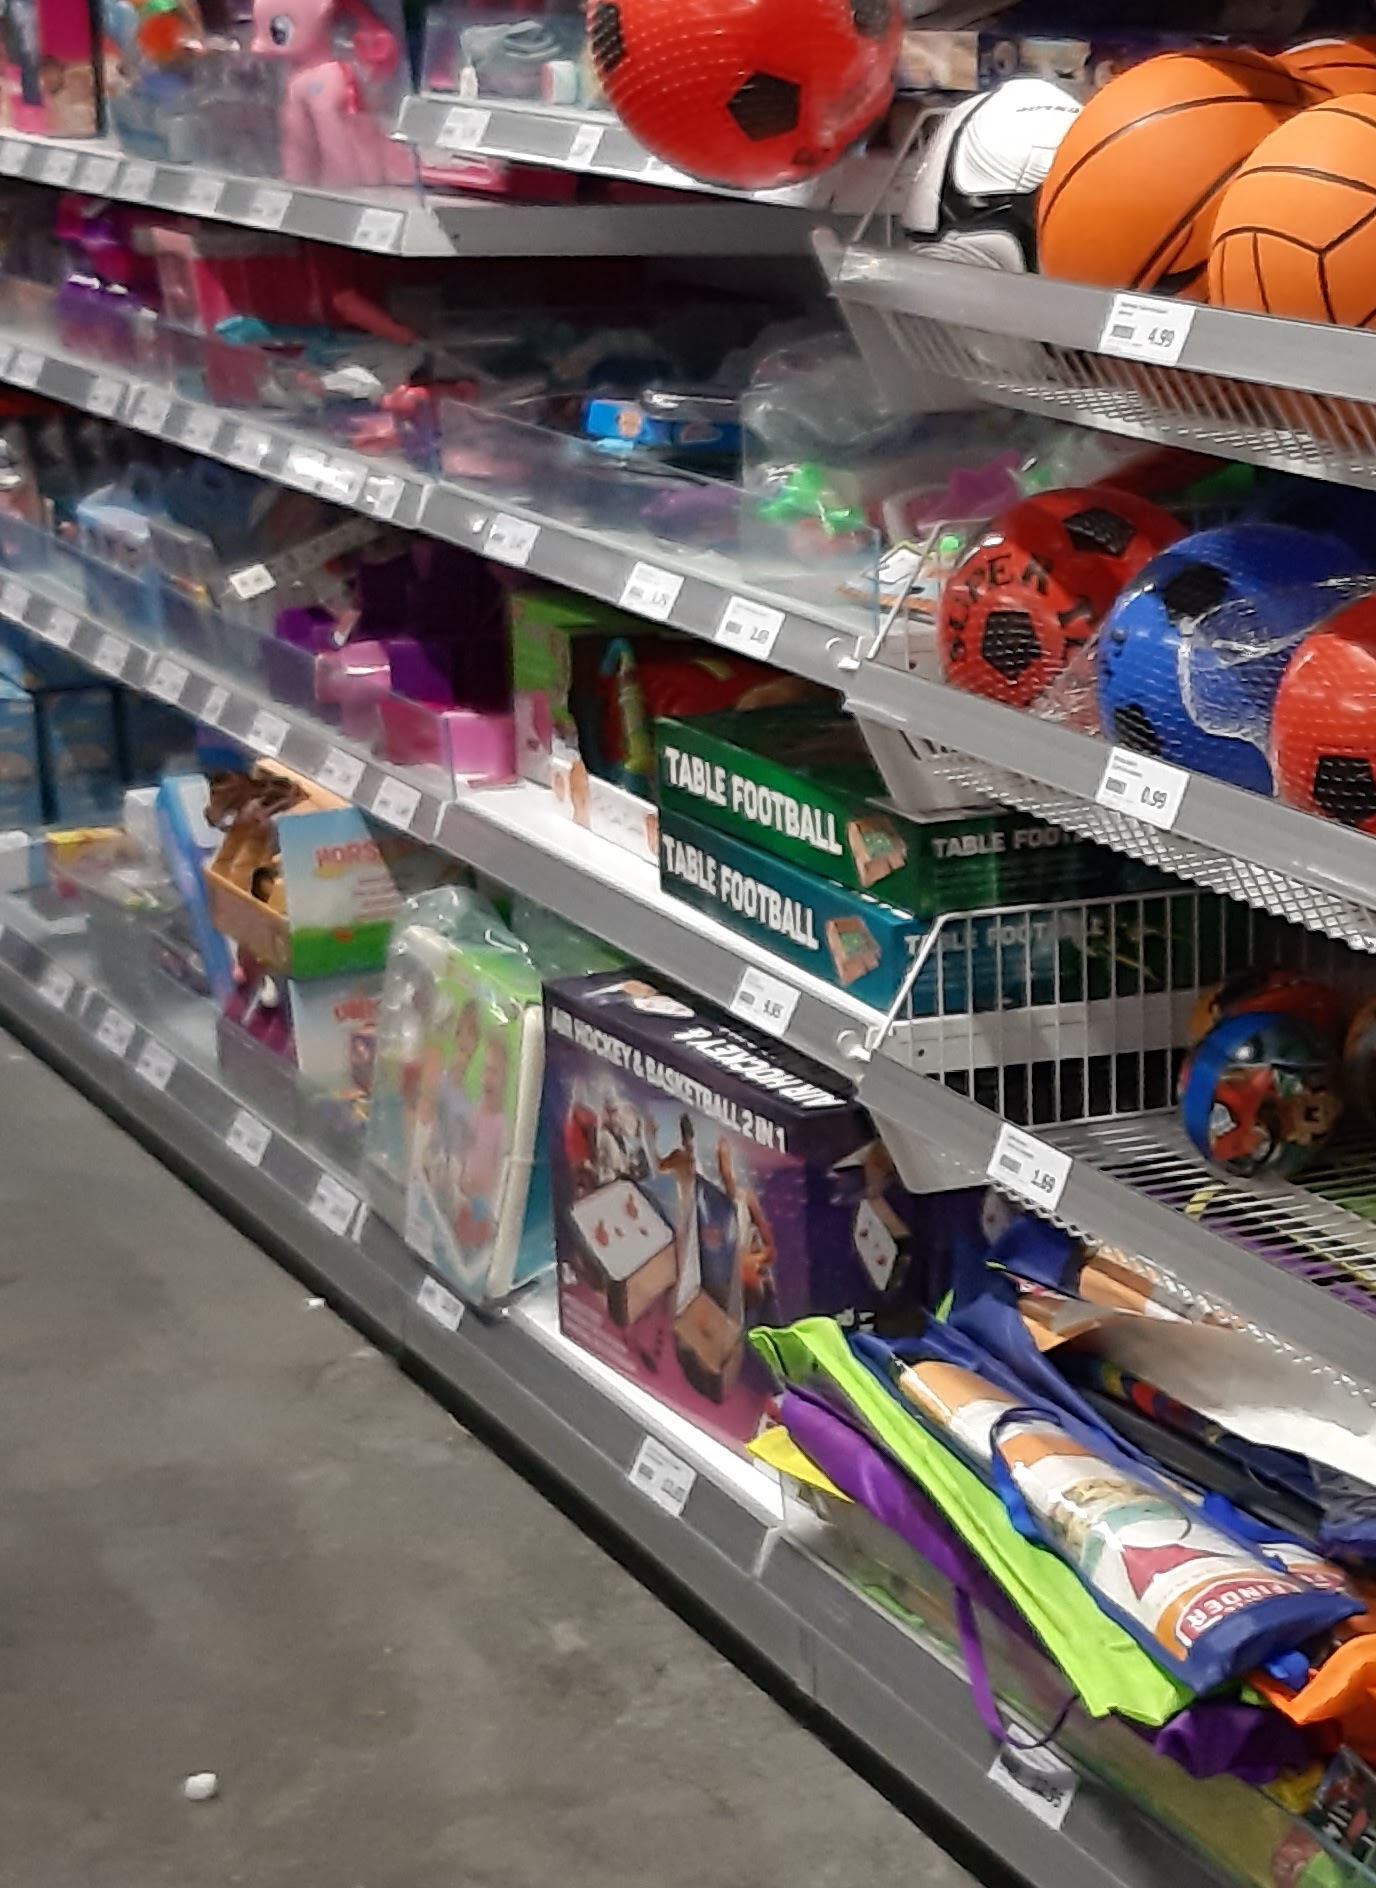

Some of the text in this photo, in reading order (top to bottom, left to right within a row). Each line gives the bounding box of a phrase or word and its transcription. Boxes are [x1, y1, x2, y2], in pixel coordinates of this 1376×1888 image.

[1148, 326, 1175, 349] 4.99
[664, 745, 845, 857] TABLE FOOTBALL
[931, 831, 1007, 860] TABLE
[664, 832, 820, 952] TABLE FOOTBALL
[551, 1006, 788, 1153] AIR HOCKEY & BASKETBALL 2 IN 1
[685, 1038, 805, 1091] HOCKEY
[777, 1080, 848, 1109] AIR
